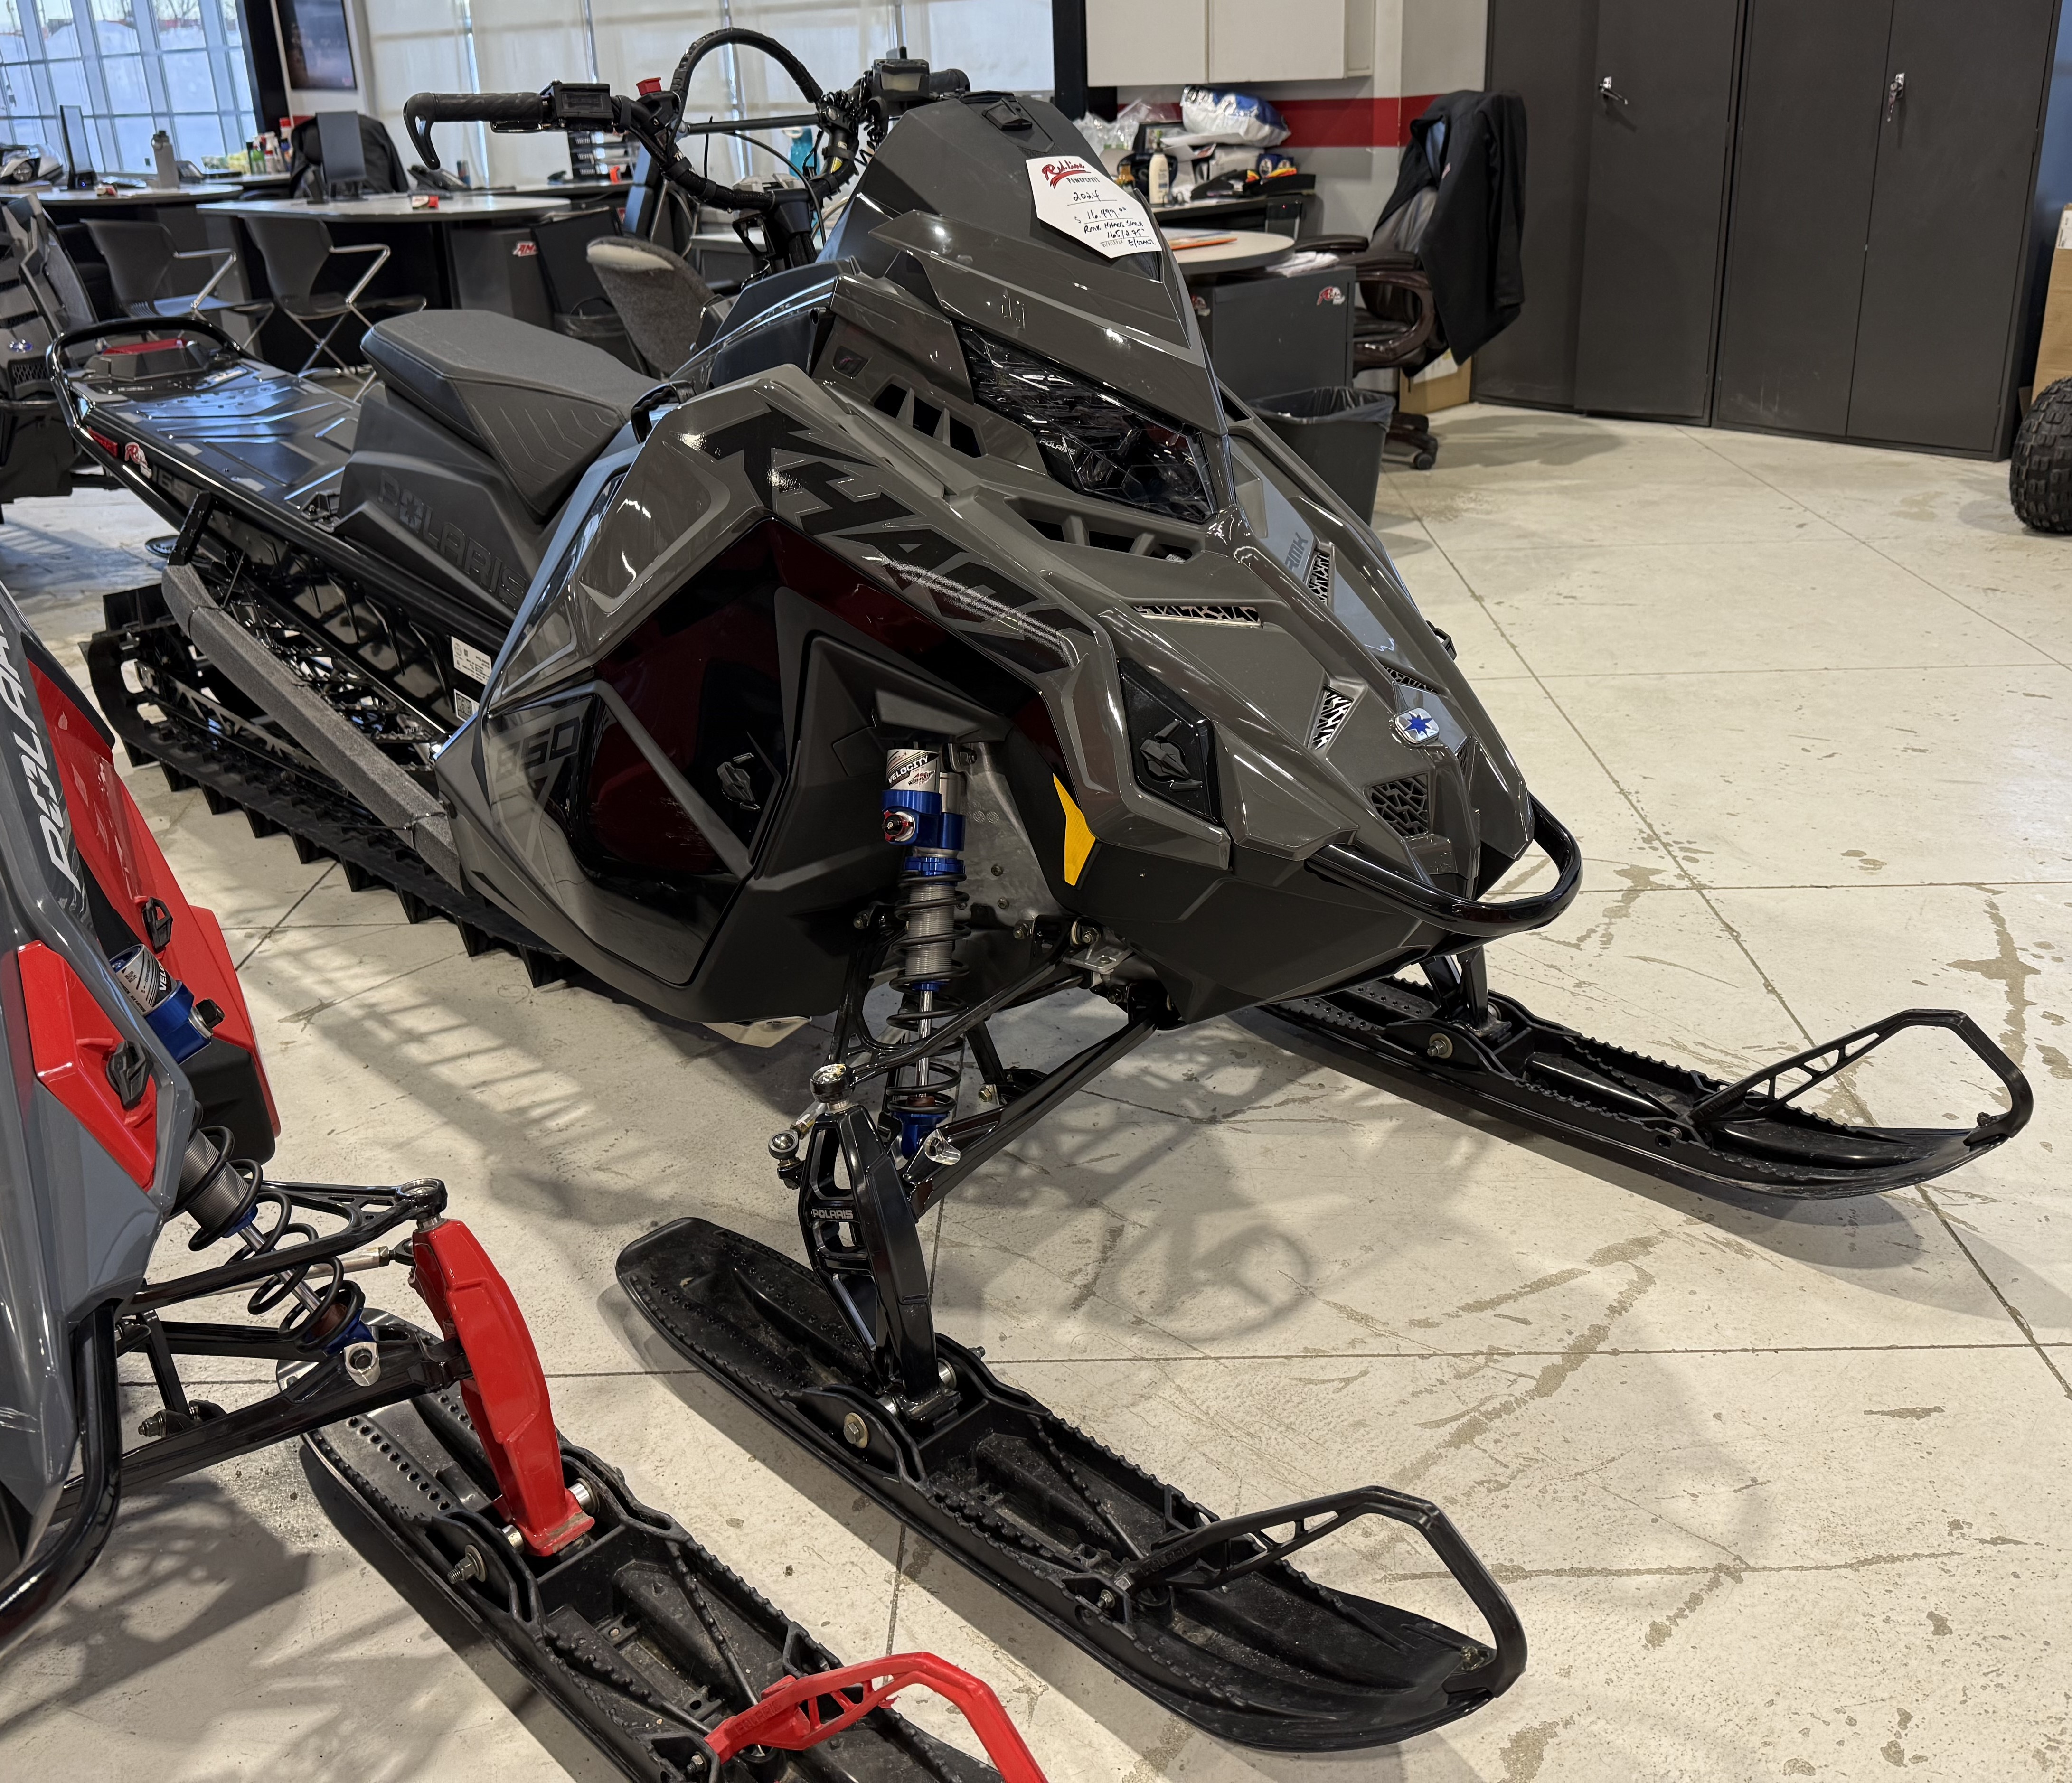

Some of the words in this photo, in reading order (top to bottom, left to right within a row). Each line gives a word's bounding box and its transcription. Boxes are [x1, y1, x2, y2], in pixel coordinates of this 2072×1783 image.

[378, 469, 527, 611] POLARIS
[678, 403, 1097, 674] KHAOS
[1284, 531, 1309, 570] RMK
[888, 755, 928, 783] VELOCITY
[811, 1209, 854, 1219] POLARIS
